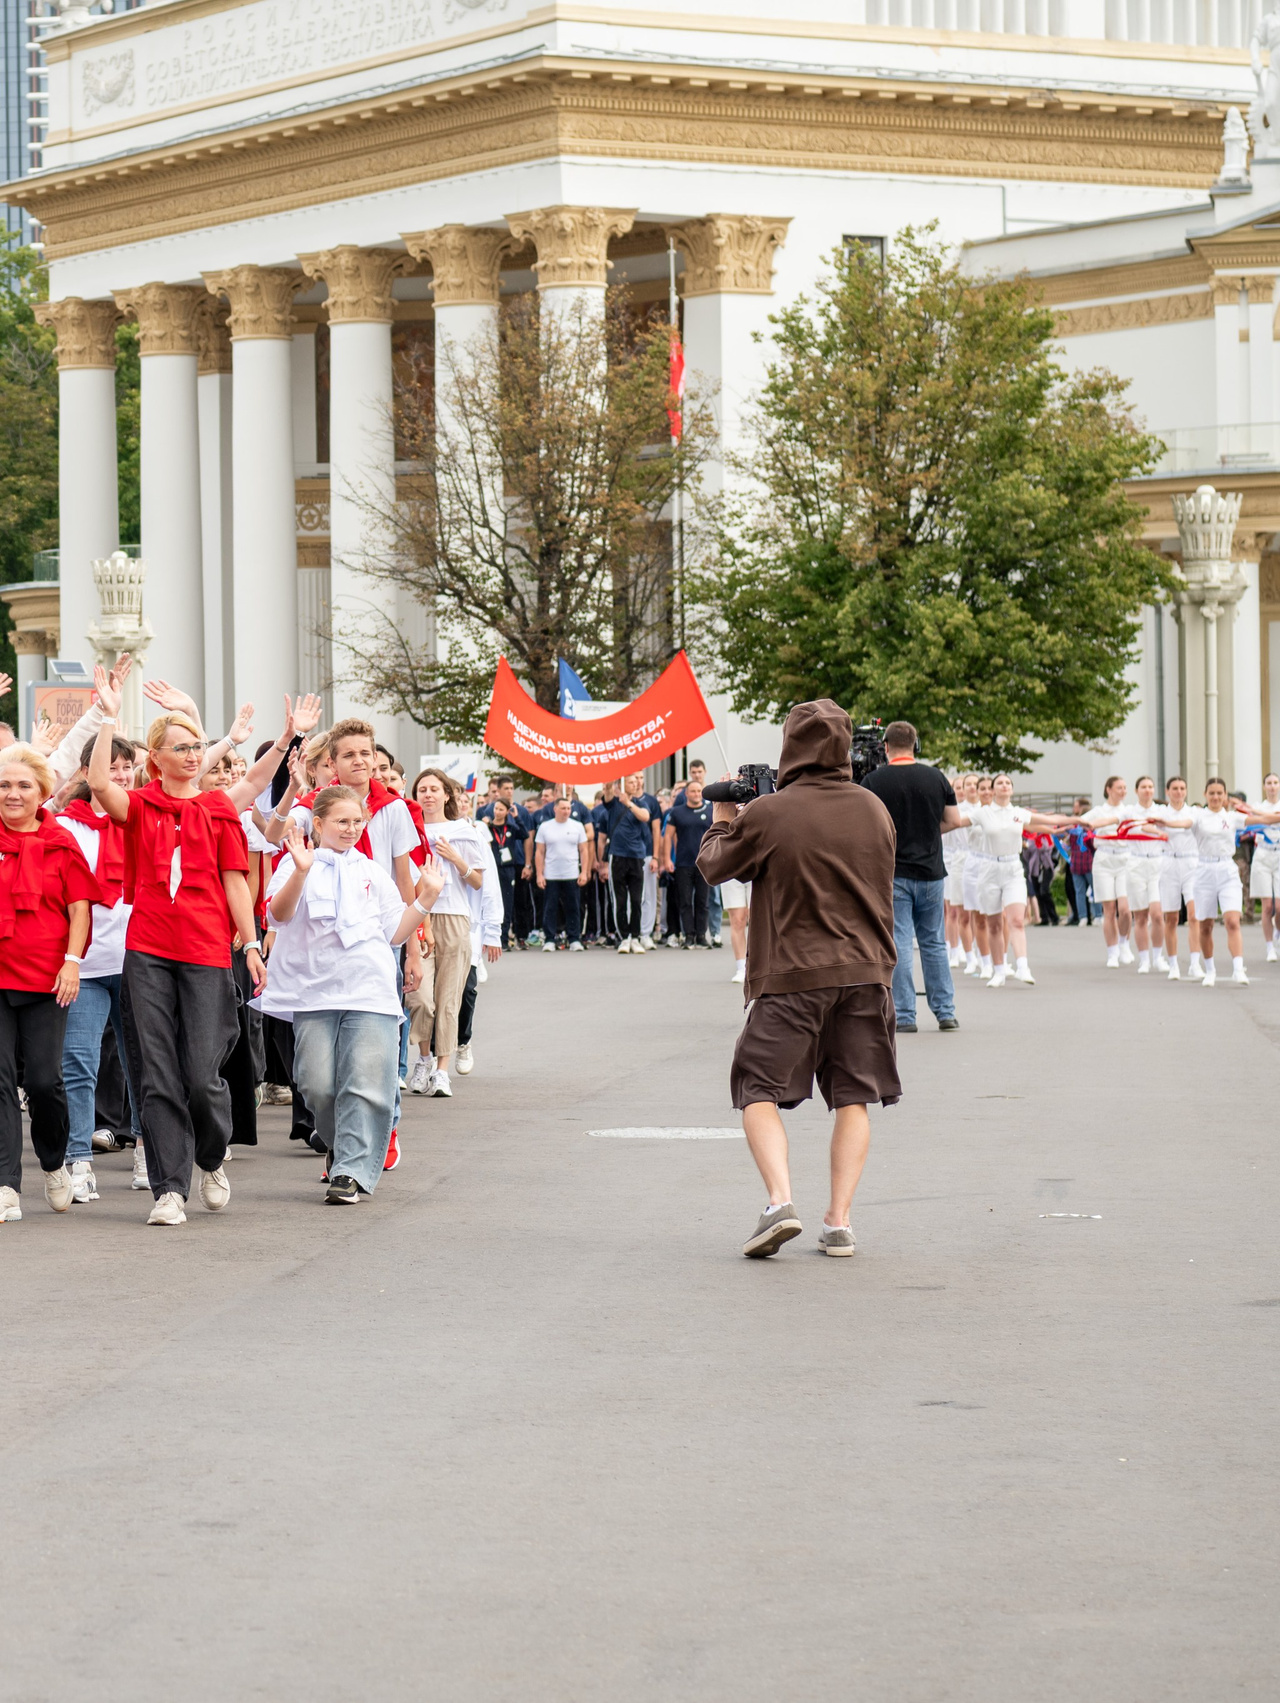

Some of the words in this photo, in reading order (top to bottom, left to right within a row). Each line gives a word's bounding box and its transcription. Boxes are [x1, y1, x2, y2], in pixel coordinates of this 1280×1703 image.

[146, 35, 257, 83] СОВЕТСКАЯ
[146, 45, 312, 108] СОЦИАЛИСТИЧЕСКАЯ
[321, 15, 436, 64] РЕСПУБЛИКА
[56, 703, 84, 717] ГОРОД
[507, 709, 555, 750] НАДЕЖДА
[557, 715, 665, 754] ЧЕЛОВЕЧЕСТВА
[513, 732, 578, 765] ЗДОРОВОЕ
[580, 728, 666, 765] ОТЕЧЕСТВО!
